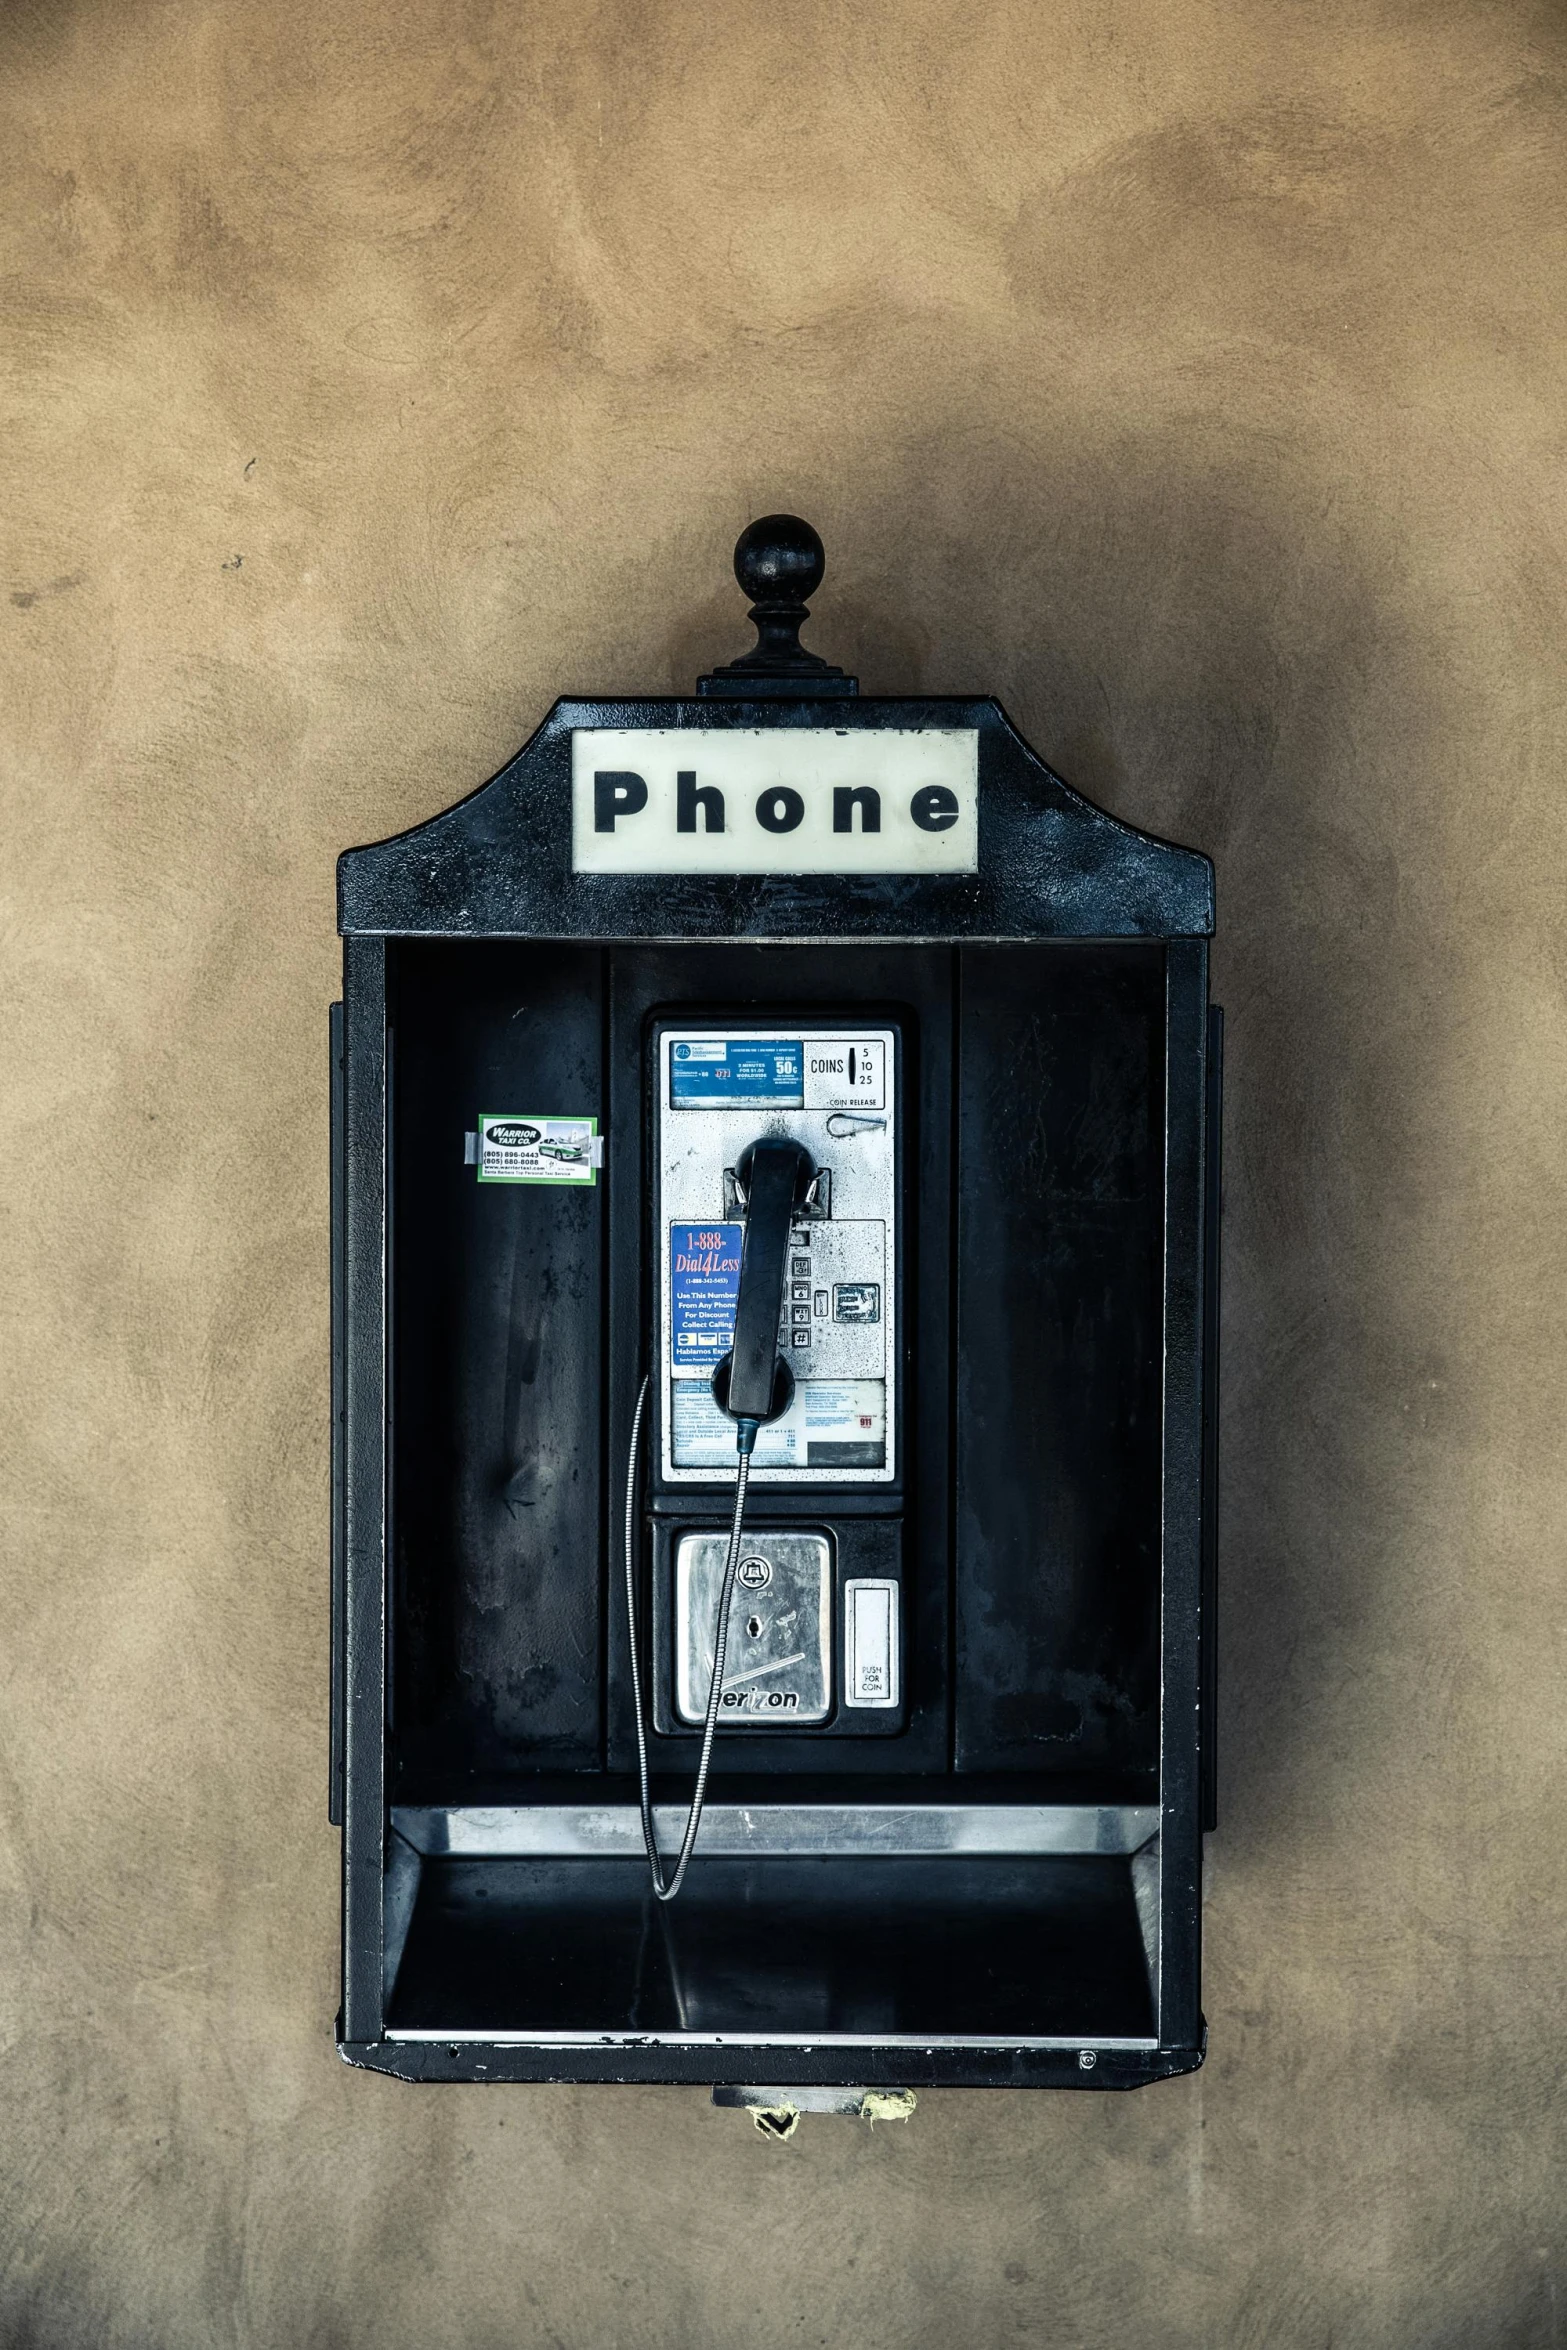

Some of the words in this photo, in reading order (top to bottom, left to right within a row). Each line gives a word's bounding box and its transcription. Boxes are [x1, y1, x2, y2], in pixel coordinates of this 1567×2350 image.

[594, 771, 959, 833] Phone
[863, 1048, 869, 1057] 5
[811, 1059, 844, 1073] COINS
[861, 1061, 873, 1071] 10
[859, 1075, 873, 1085] 25
[498, 1137, 518, 1145] TAXI
[483, 1151, 503, 1159] (805)
[483, 1158, 503, 1166] (805)
[687, 1232, 727, 1250] 1-888-
[675, 1251, 740, 1277] Dial4Less
[698, 1302, 713, 1310] Any
[708, 1321, 733, 1329] Calling
[860, 1418, 872, 1426] 911
[862, 1666, 882, 1674] PUSH
[862, 1683, 882, 1691] COIN
